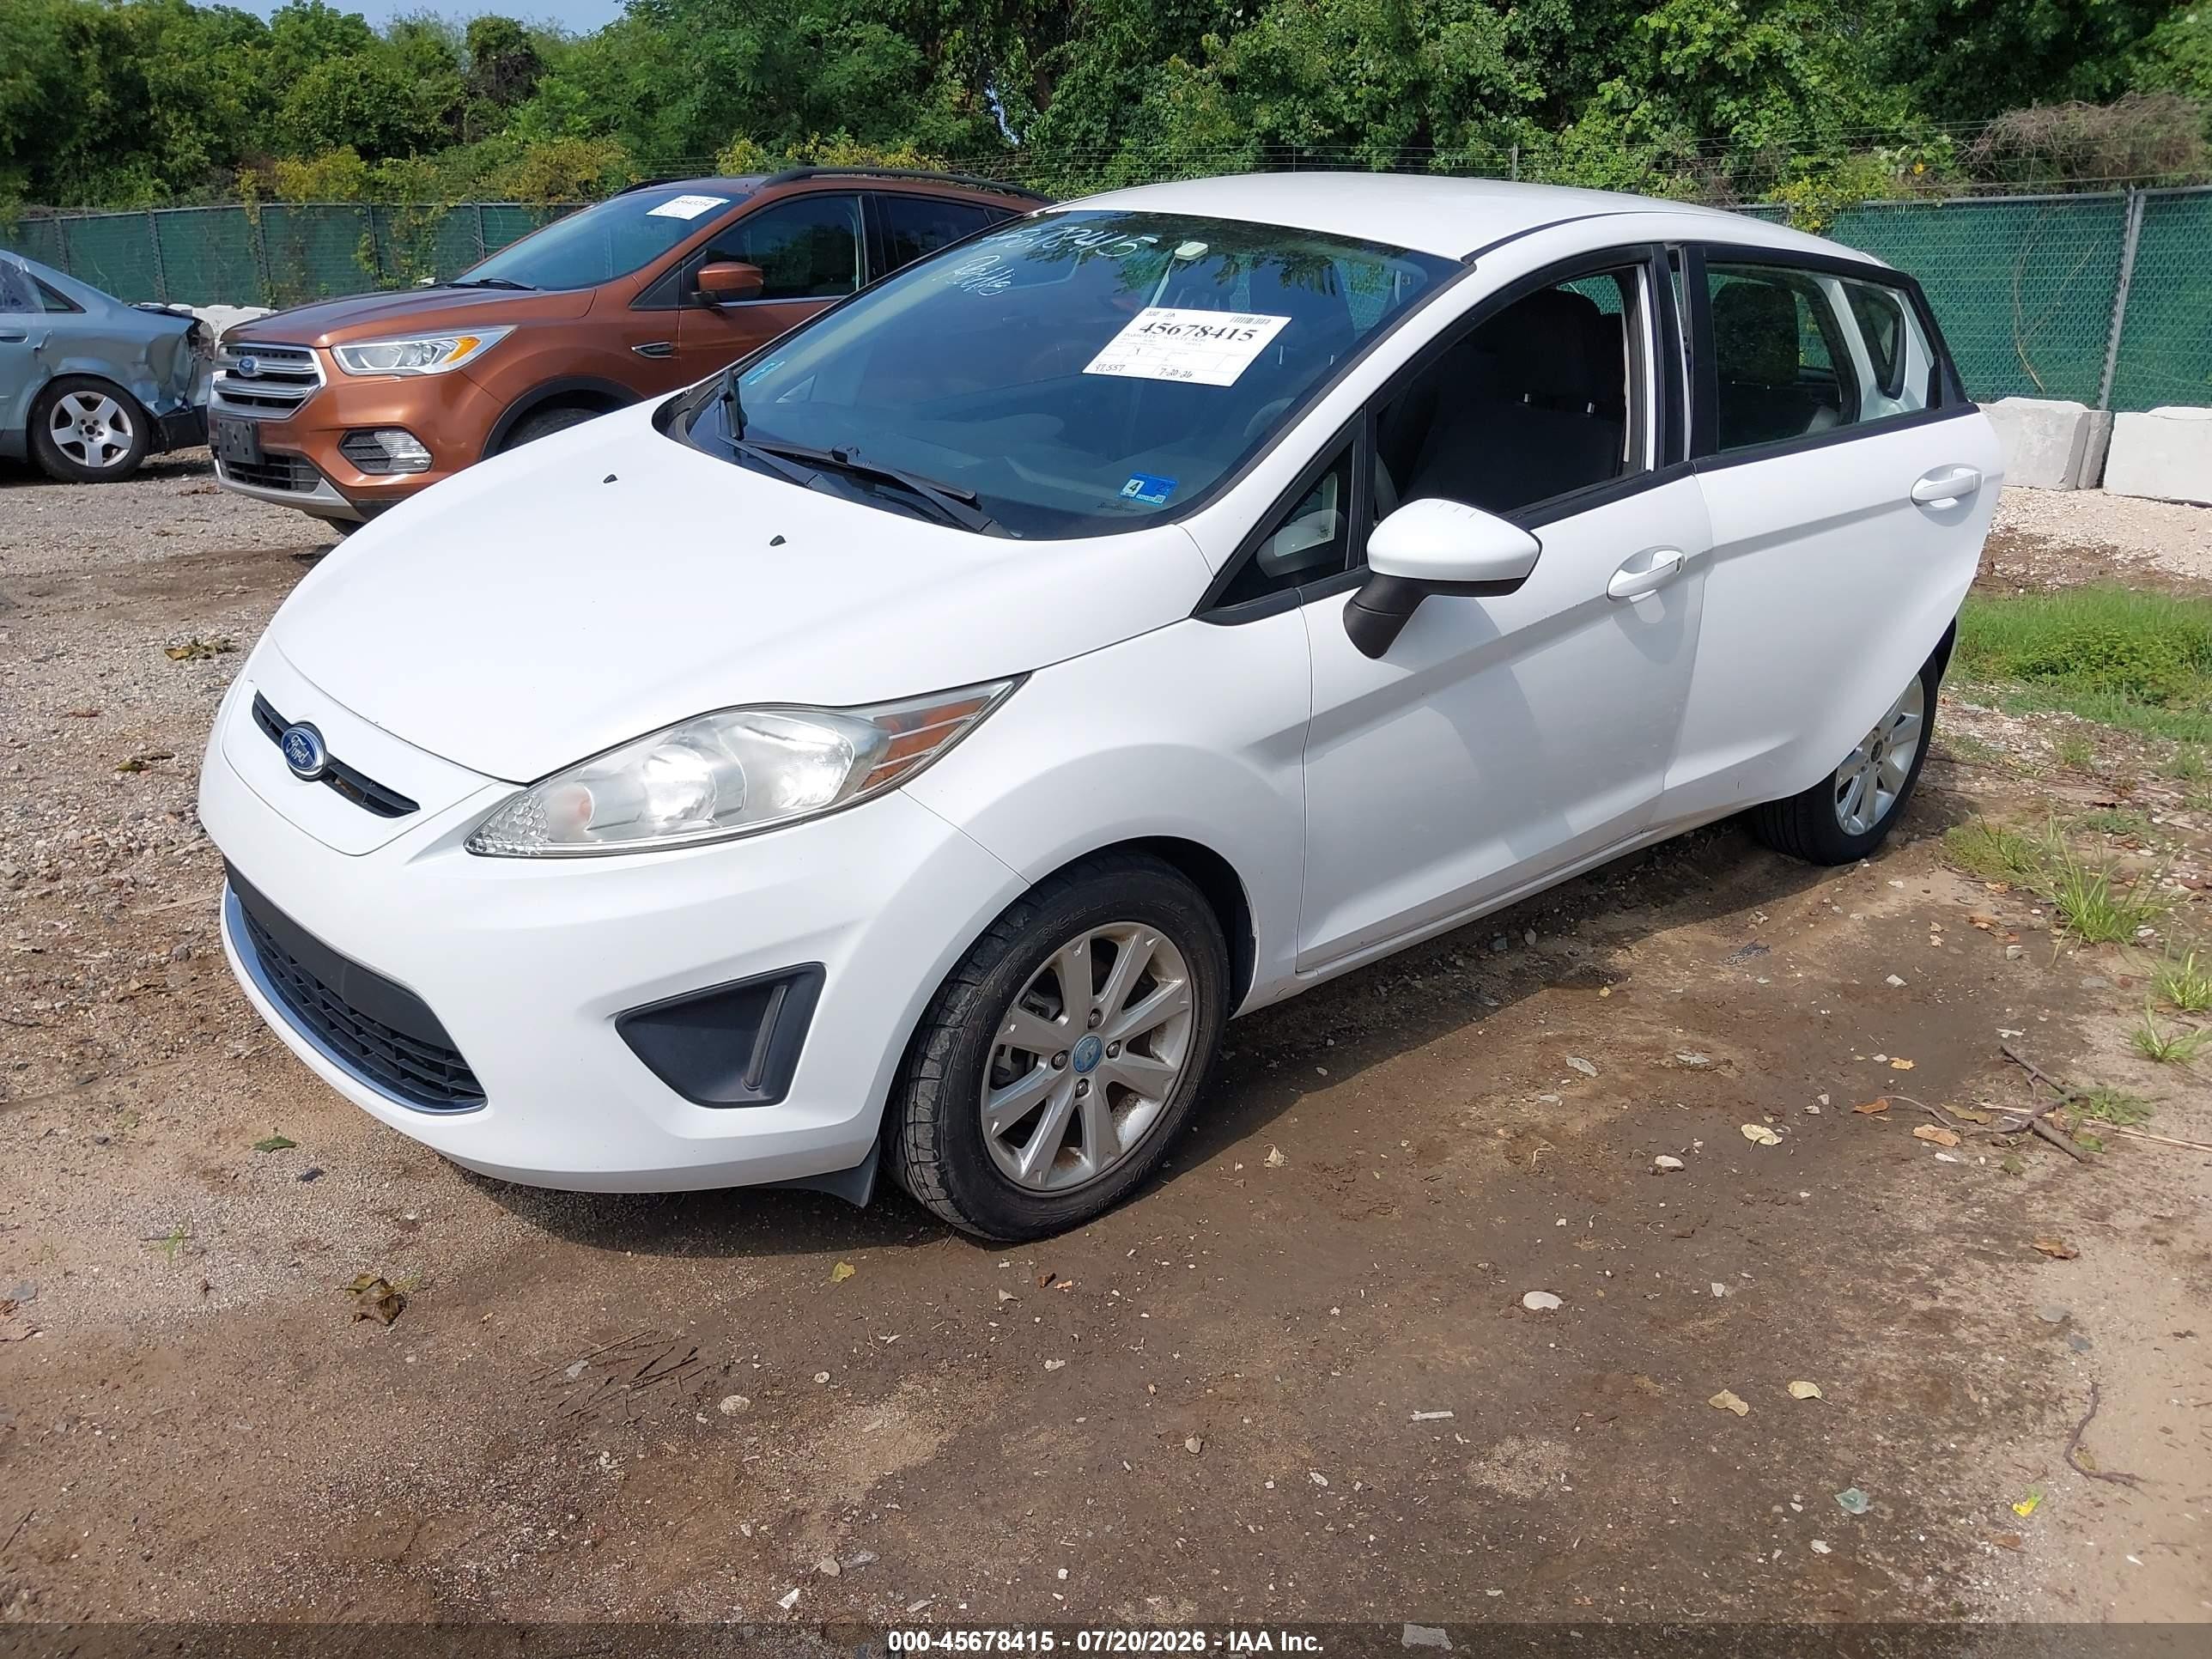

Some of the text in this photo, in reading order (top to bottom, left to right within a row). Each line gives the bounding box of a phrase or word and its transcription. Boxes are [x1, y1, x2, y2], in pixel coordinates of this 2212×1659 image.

[1139, 321, 1258, 342] 45678415
[1129, 482, 1140, 493] 4
[285, 734, 310, 764] Ford
